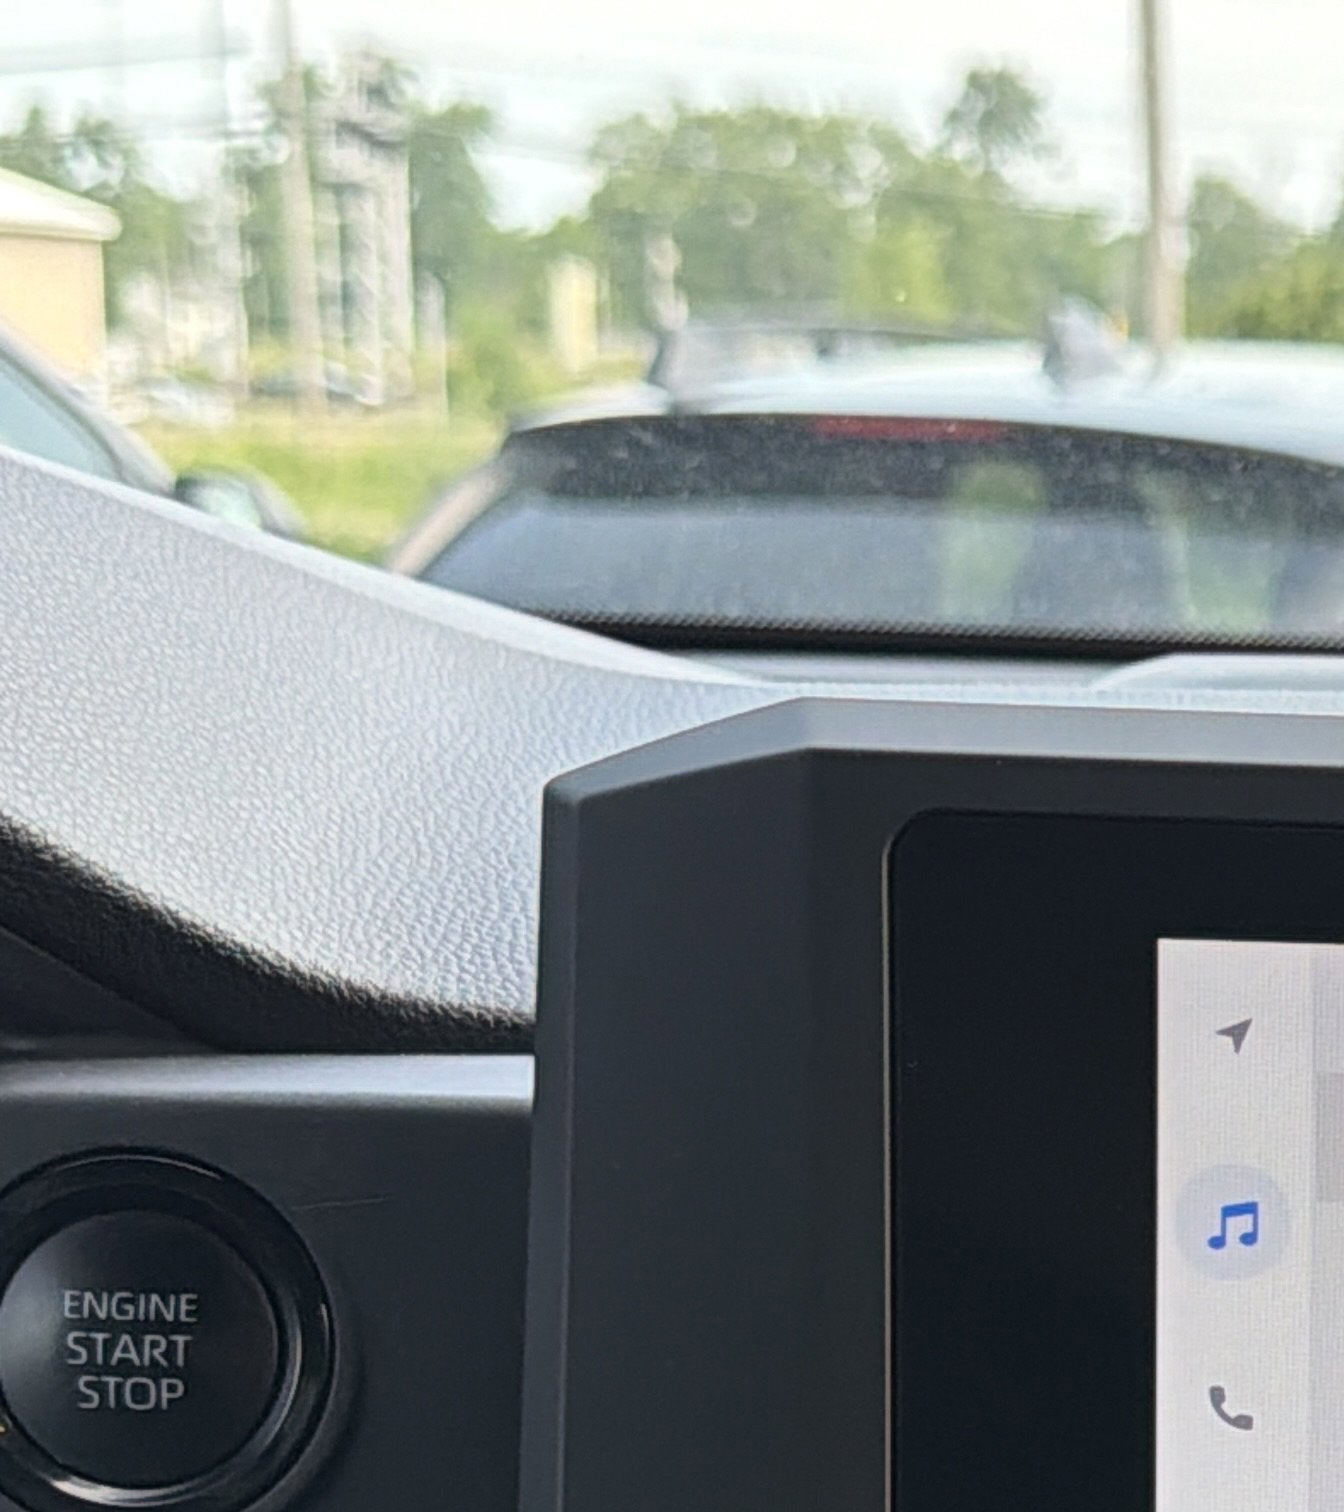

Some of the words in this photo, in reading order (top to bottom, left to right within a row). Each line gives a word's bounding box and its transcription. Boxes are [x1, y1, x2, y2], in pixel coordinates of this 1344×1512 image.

[62, 1289, 198, 1323] ENGINE
[65, 1330, 193, 1367] START
[77, 1374, 185, 1410] STOP
